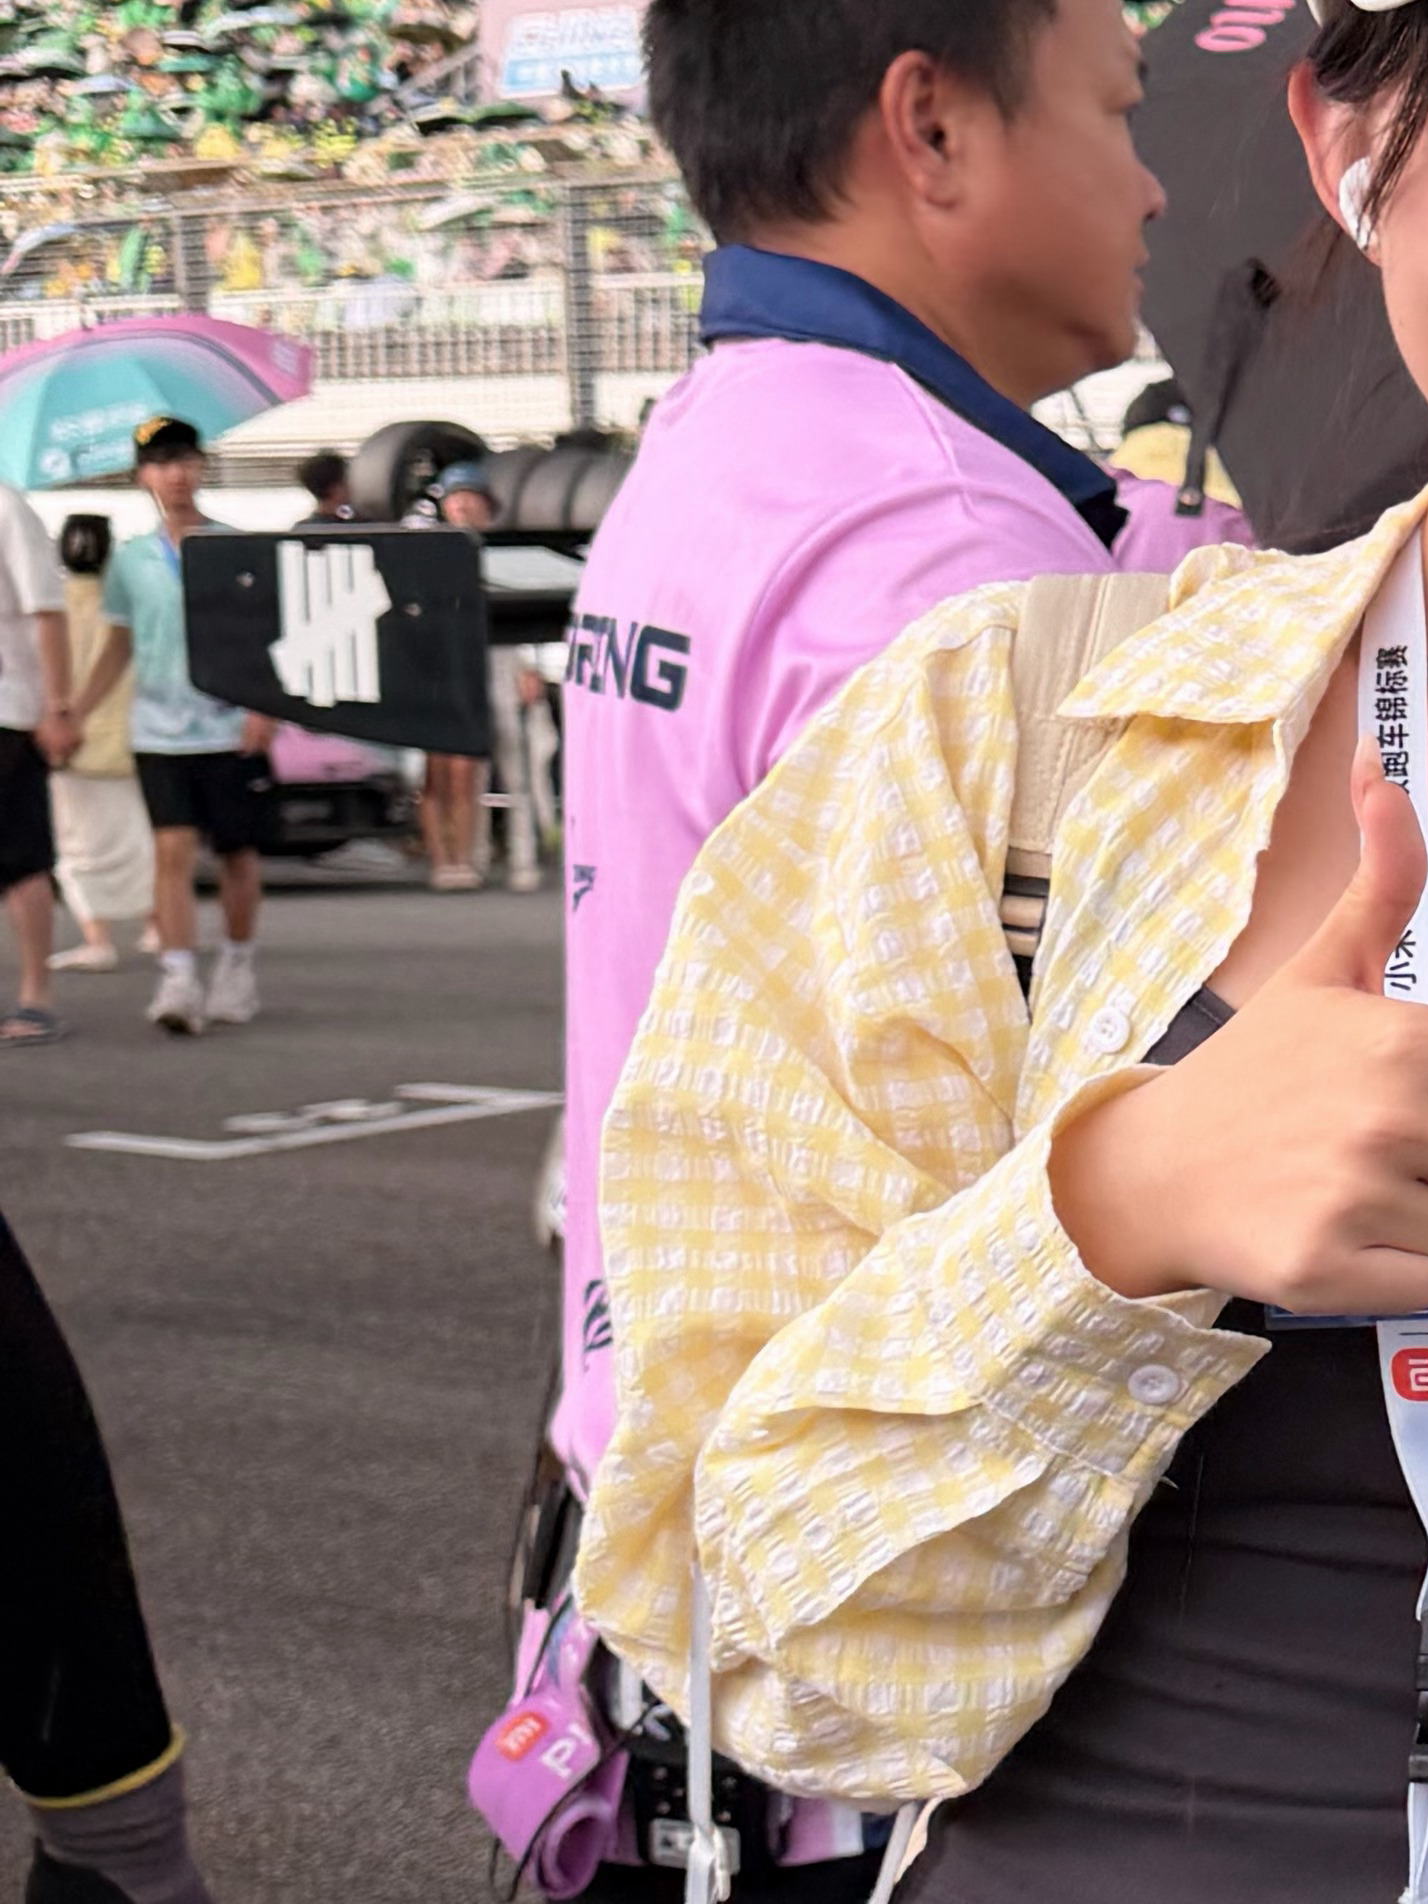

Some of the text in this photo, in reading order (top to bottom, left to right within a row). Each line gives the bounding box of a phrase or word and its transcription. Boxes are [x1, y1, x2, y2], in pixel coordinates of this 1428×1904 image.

[1376, 645, 1410, 795] 跑车锦标赛
